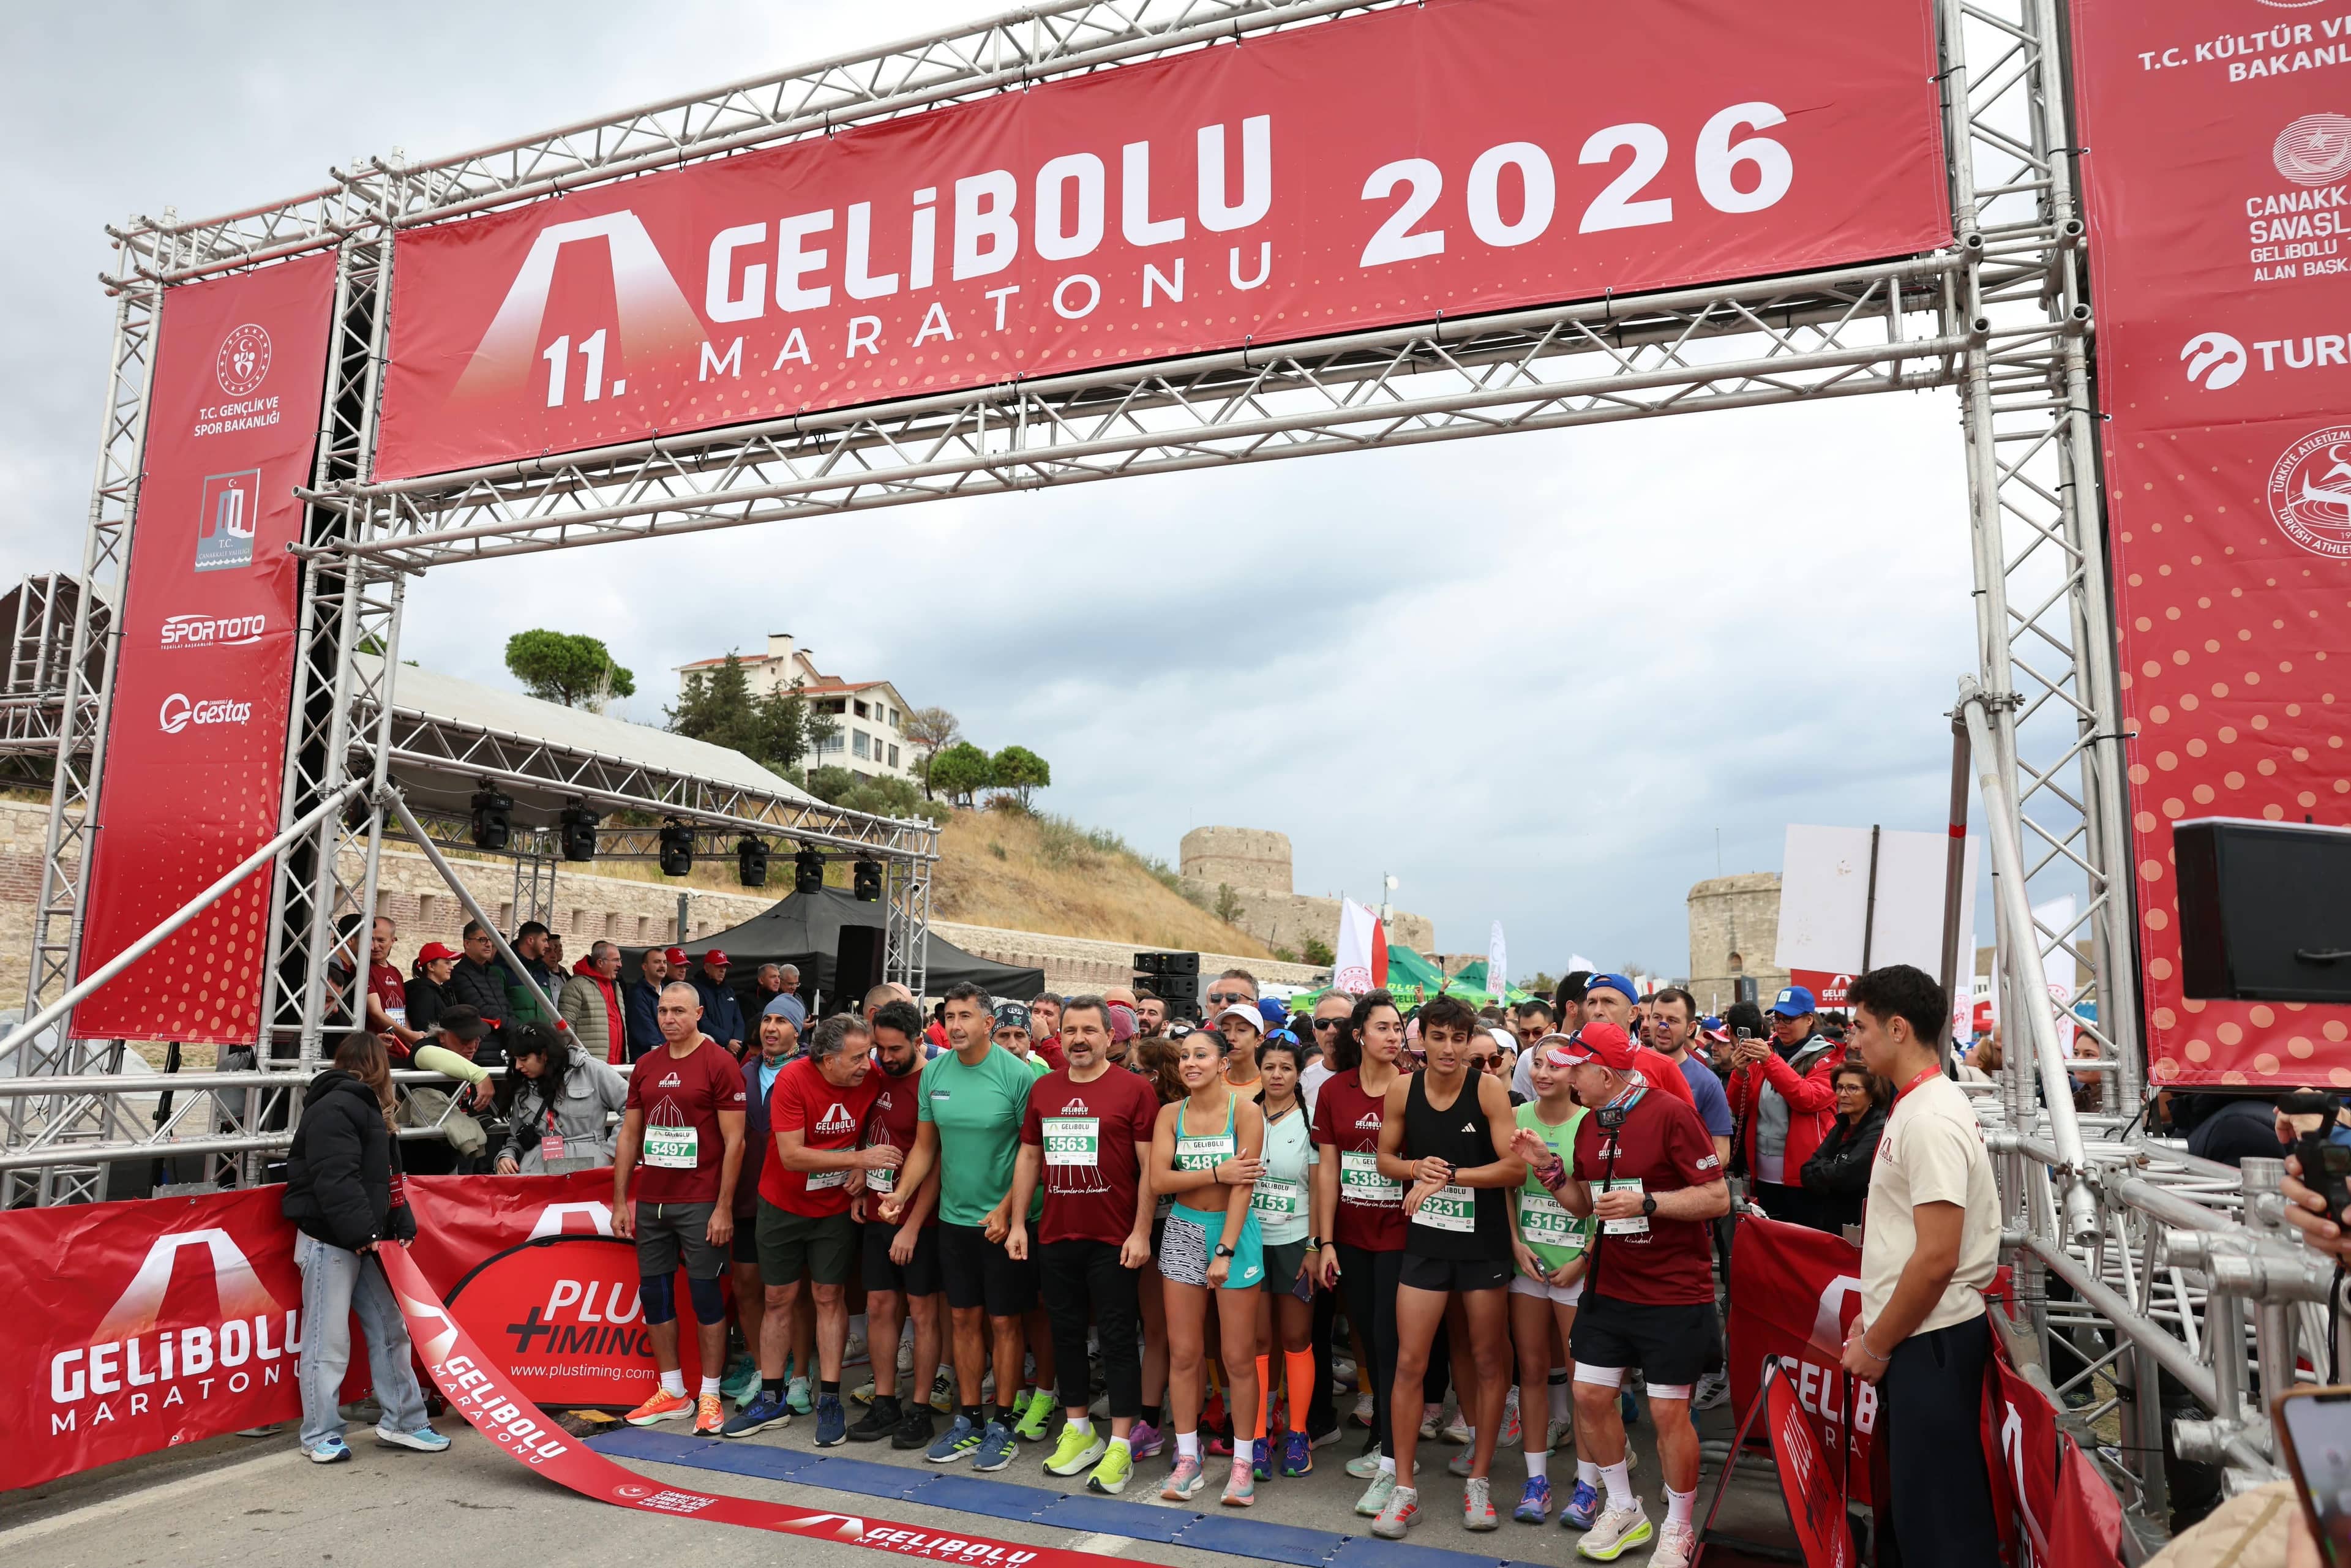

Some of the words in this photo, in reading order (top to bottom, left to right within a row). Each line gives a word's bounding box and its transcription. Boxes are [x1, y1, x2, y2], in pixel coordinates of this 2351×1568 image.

[2138, 48, 2188, 71] T.C.
[2195, 23, 2313, 62] KÜLTÜR
[1359, 101, 1794, 268] 2026
[2246, 185, 2351, 219] ÇANAKK
[2254, 264, 2296, 282] ALAN
[2303, 257, 2351, 276] BAŞK
[699, 241, 1272, 382] MARATONU
[2253, 332, 2351, 372] TUR
[542, 328, 625, 407] 11.
[200, 407, 217, 420] T.C.
[220, 397, 264, 416] GENÇLİK
[266, 396, 279, 408] VE
[194, 422, 222, 437] SPOR
[225, 410, 280, 432] BAKANLIĞI
[2271, 452, 2299, 493] TÜRKİYE
[2298, 430, 2350, 455] ATLETİZM
[219, 539, 233, 548] T.C.
[2278, 507, 2312, 544] TURKISH
[2312, 539, 2351, 554] ATHLE
[193, 699, 252, 725] Gestaş
[651, 1142, 689, 1156] 5497
[1049, 1137, 1088, 1152] 5563
[1182, 1154, 1222, 1170] 5481
[1349, 1171, 1392, 1187] 5389
[1422, 1197, 1464, 1217] 5231
[1530, 1212, 1578, 1232] 5157
[544, 1279, 647, 1324] PLU
[510, 1363, 655, 1381] www.plustiming.com
[431, 1364, 544, 1464] MARATONU
[854, 1537, 1021, 1568] MARATONU
